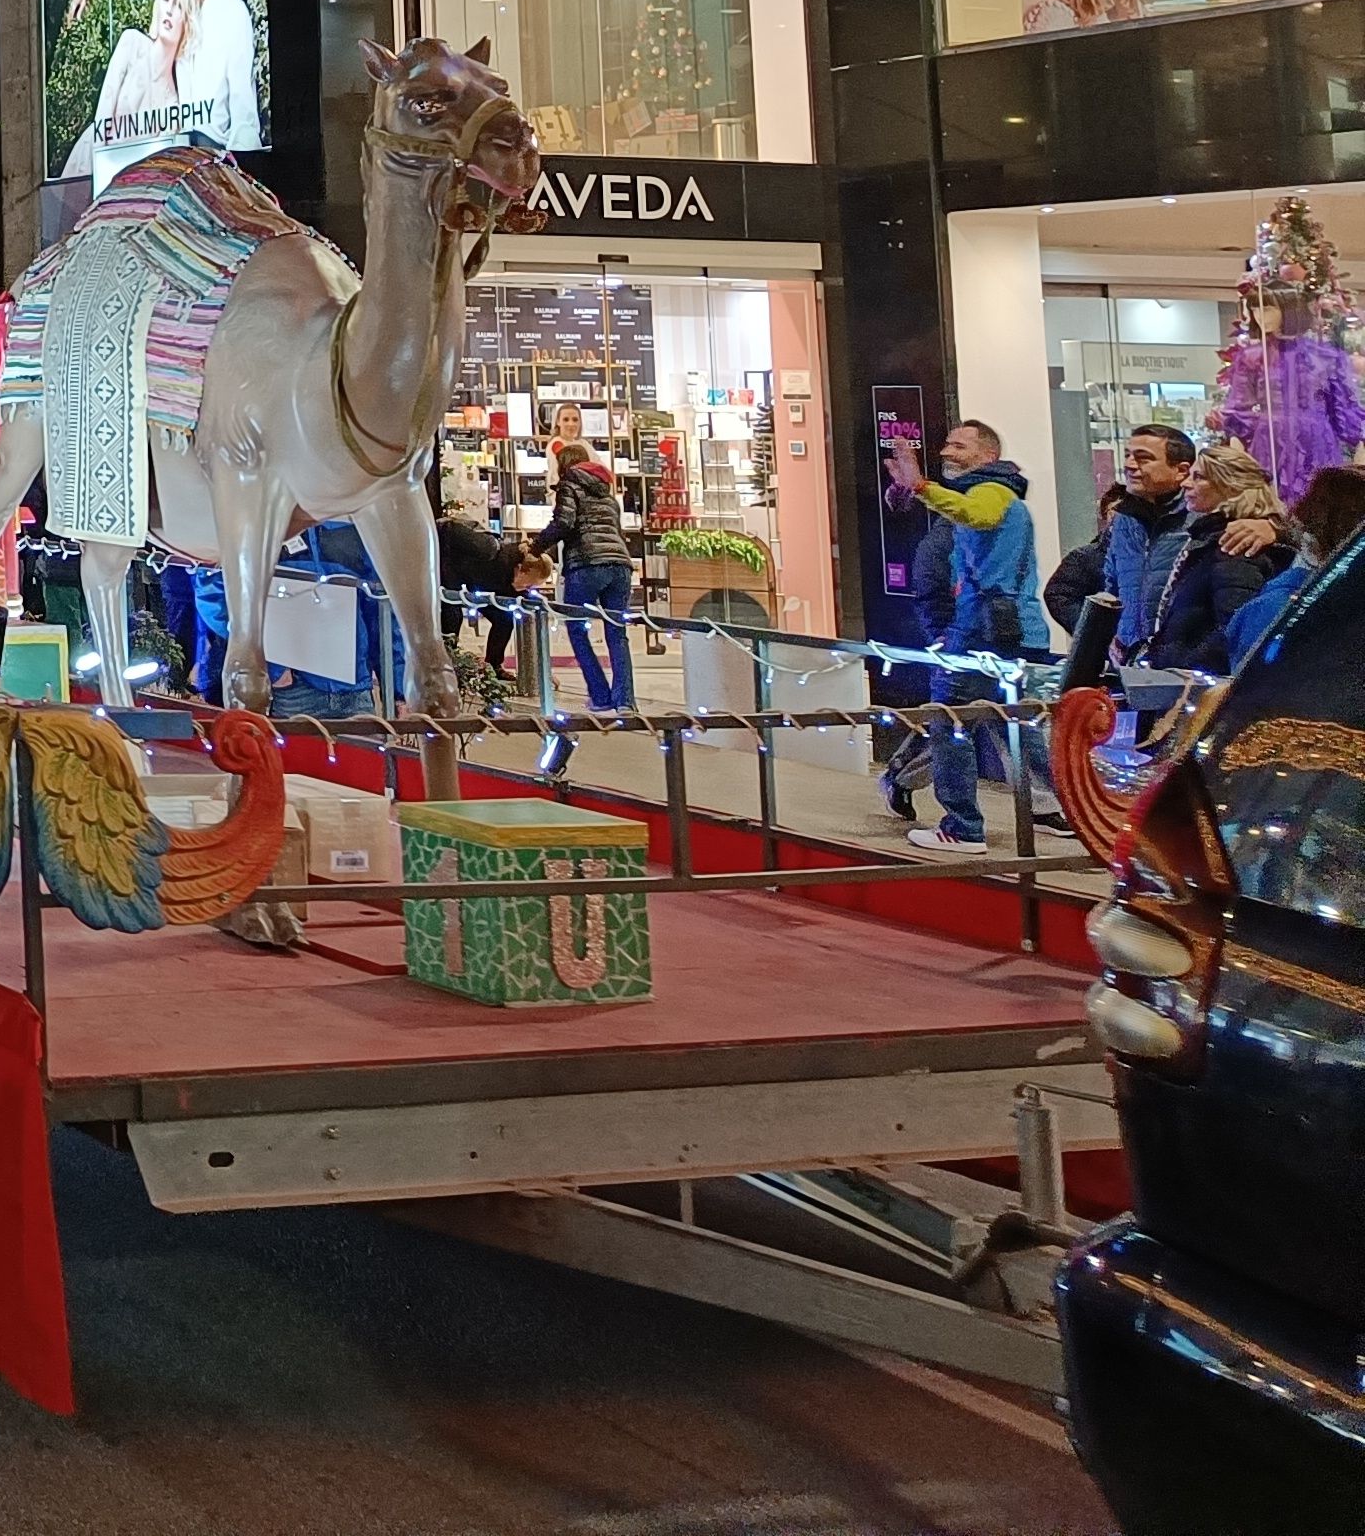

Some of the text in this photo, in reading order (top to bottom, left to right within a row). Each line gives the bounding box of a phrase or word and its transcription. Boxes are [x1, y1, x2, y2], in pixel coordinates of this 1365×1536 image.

[92, 97, 215, 144] KEVIN.MURPHY
[527, 171, 715, 222] AVEDA
[879, 421, 921, 439] 50%
